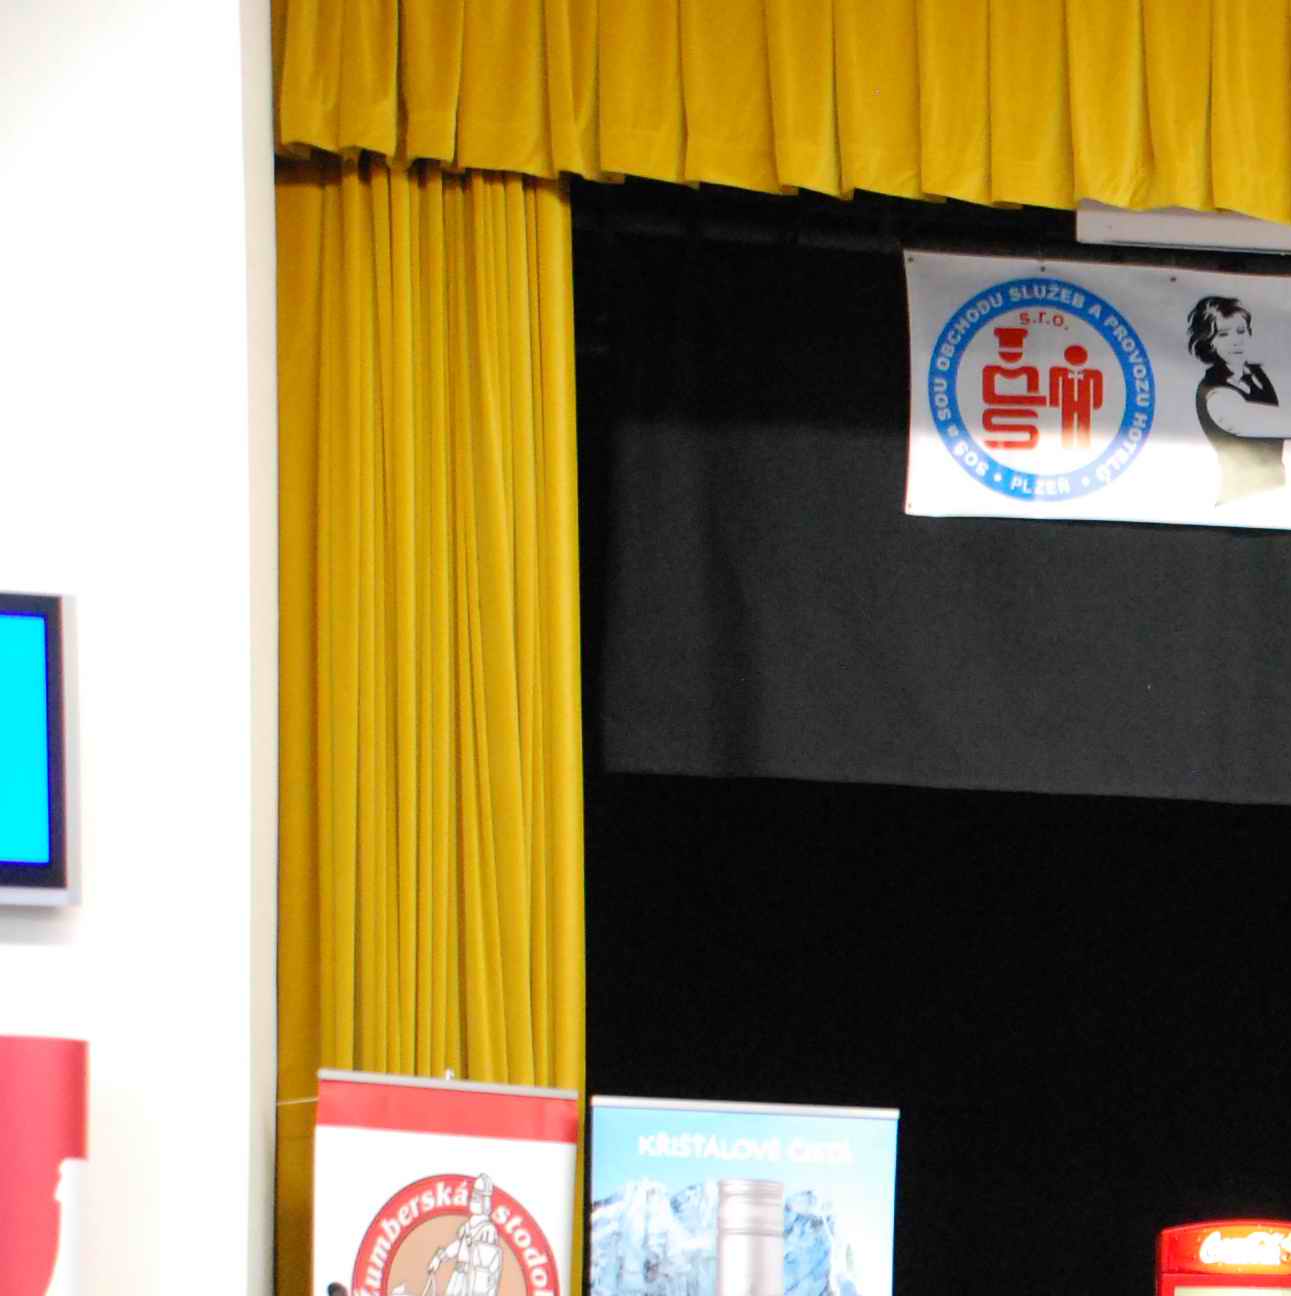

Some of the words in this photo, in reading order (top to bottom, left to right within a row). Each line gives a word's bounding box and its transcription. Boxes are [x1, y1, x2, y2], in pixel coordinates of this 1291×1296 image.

[936, 293, 1003, 371] OBCHODU
[1104, 316, 1151, 407] PROVOZU
[934, 379, 951, 420] SOU
